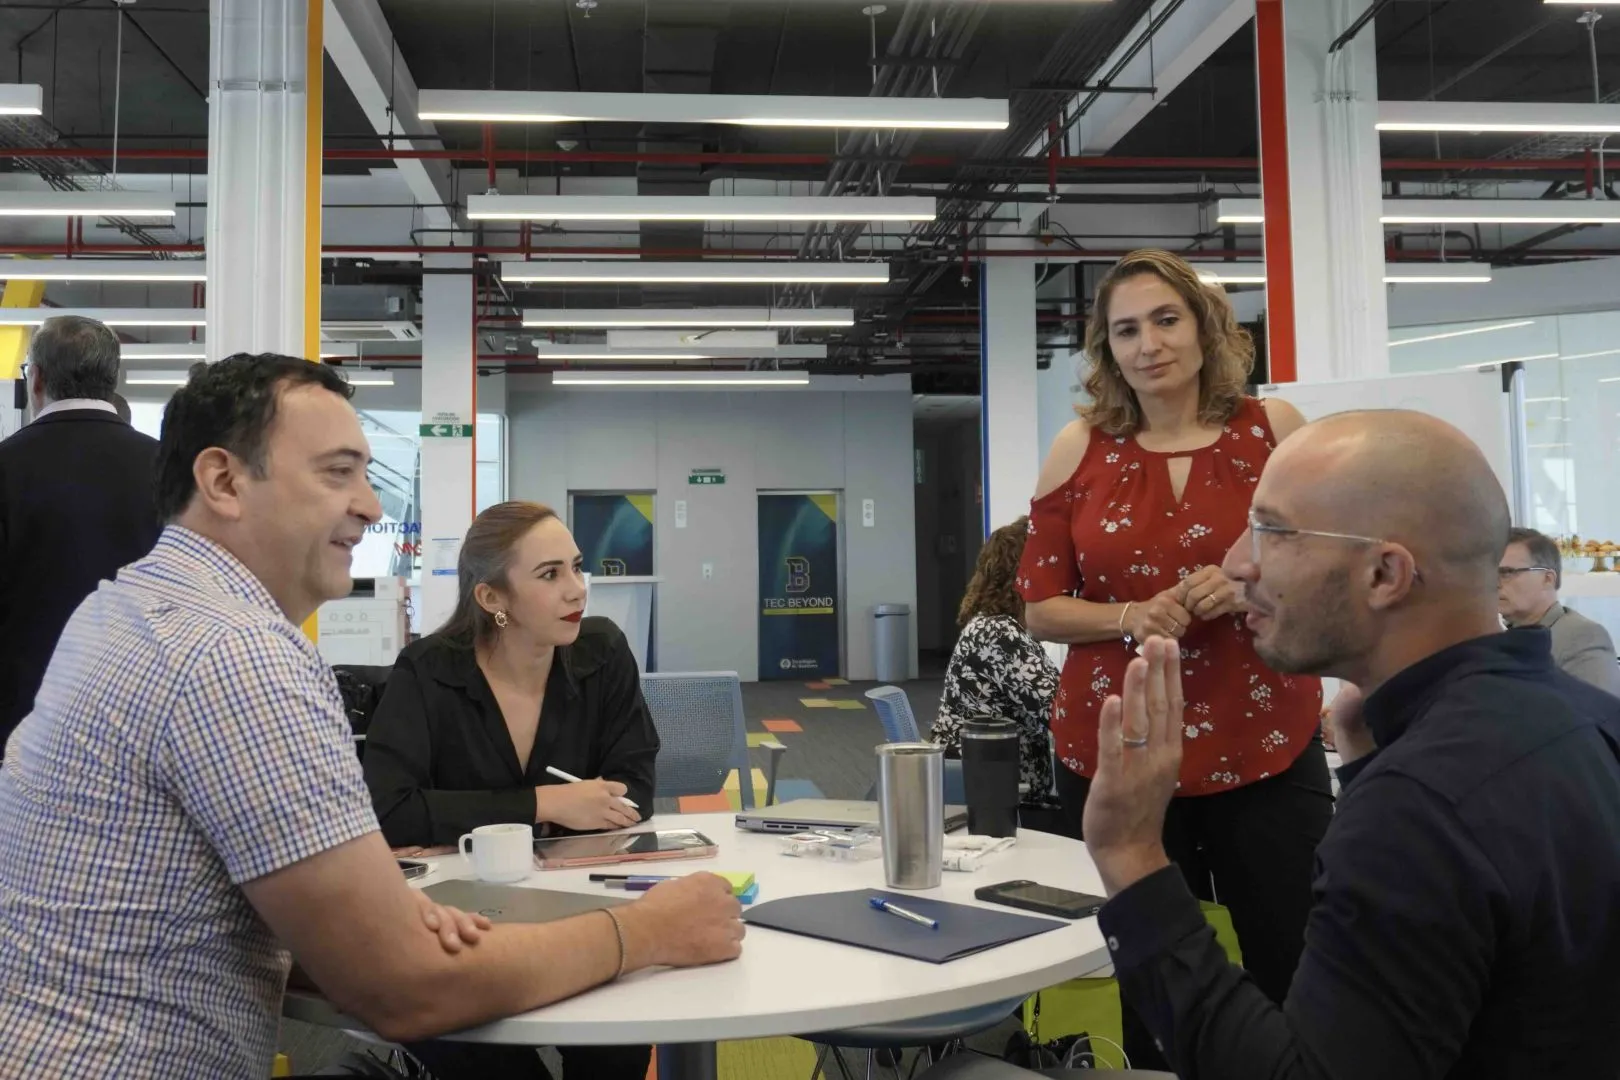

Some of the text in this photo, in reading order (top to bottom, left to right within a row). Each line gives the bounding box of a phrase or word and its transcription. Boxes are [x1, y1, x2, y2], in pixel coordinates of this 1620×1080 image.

[785, 556, 810, 593] B
[763, 597, 834, 608] TEC BEYOND
